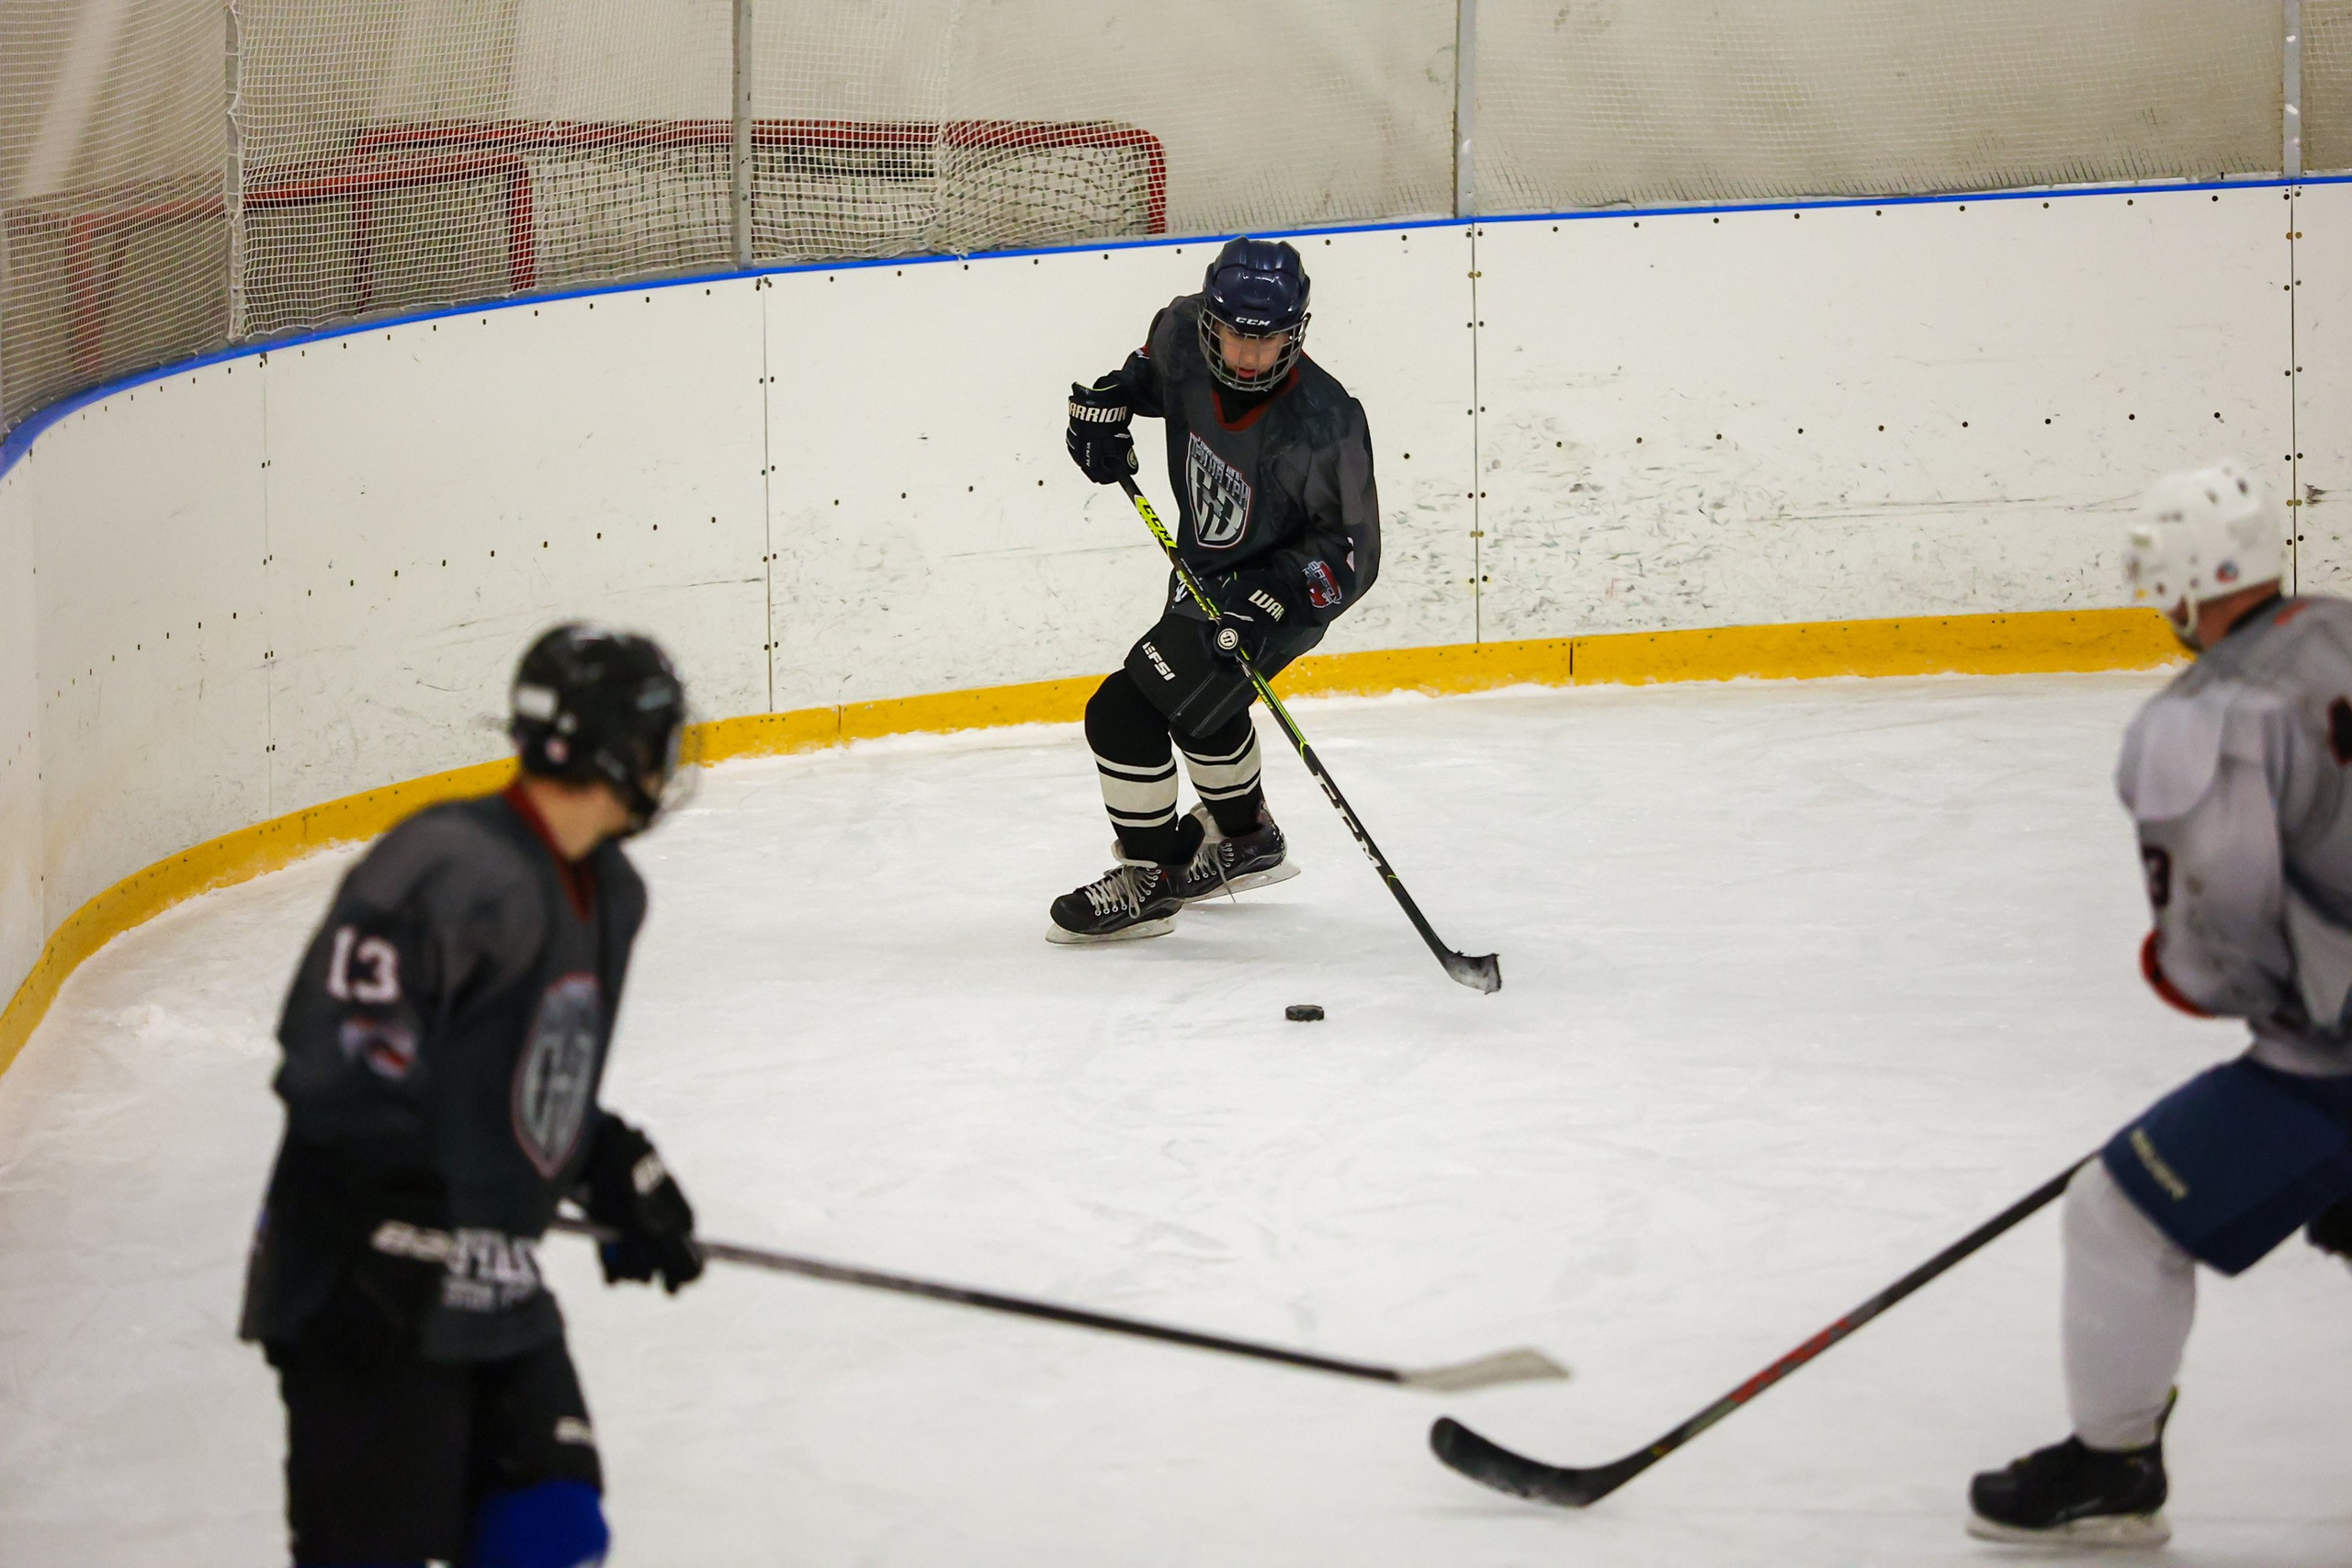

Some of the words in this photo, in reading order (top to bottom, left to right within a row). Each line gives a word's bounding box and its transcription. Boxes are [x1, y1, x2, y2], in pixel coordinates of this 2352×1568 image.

[1236, 316, 1271, 327] CCM
[1069, 400, 1127, 423] ARRIOR
[1142, 503, 1173, 542] CCM
[1141, 641, 1176, 681] EFSI
[328, 925, 400, 1003] 13
